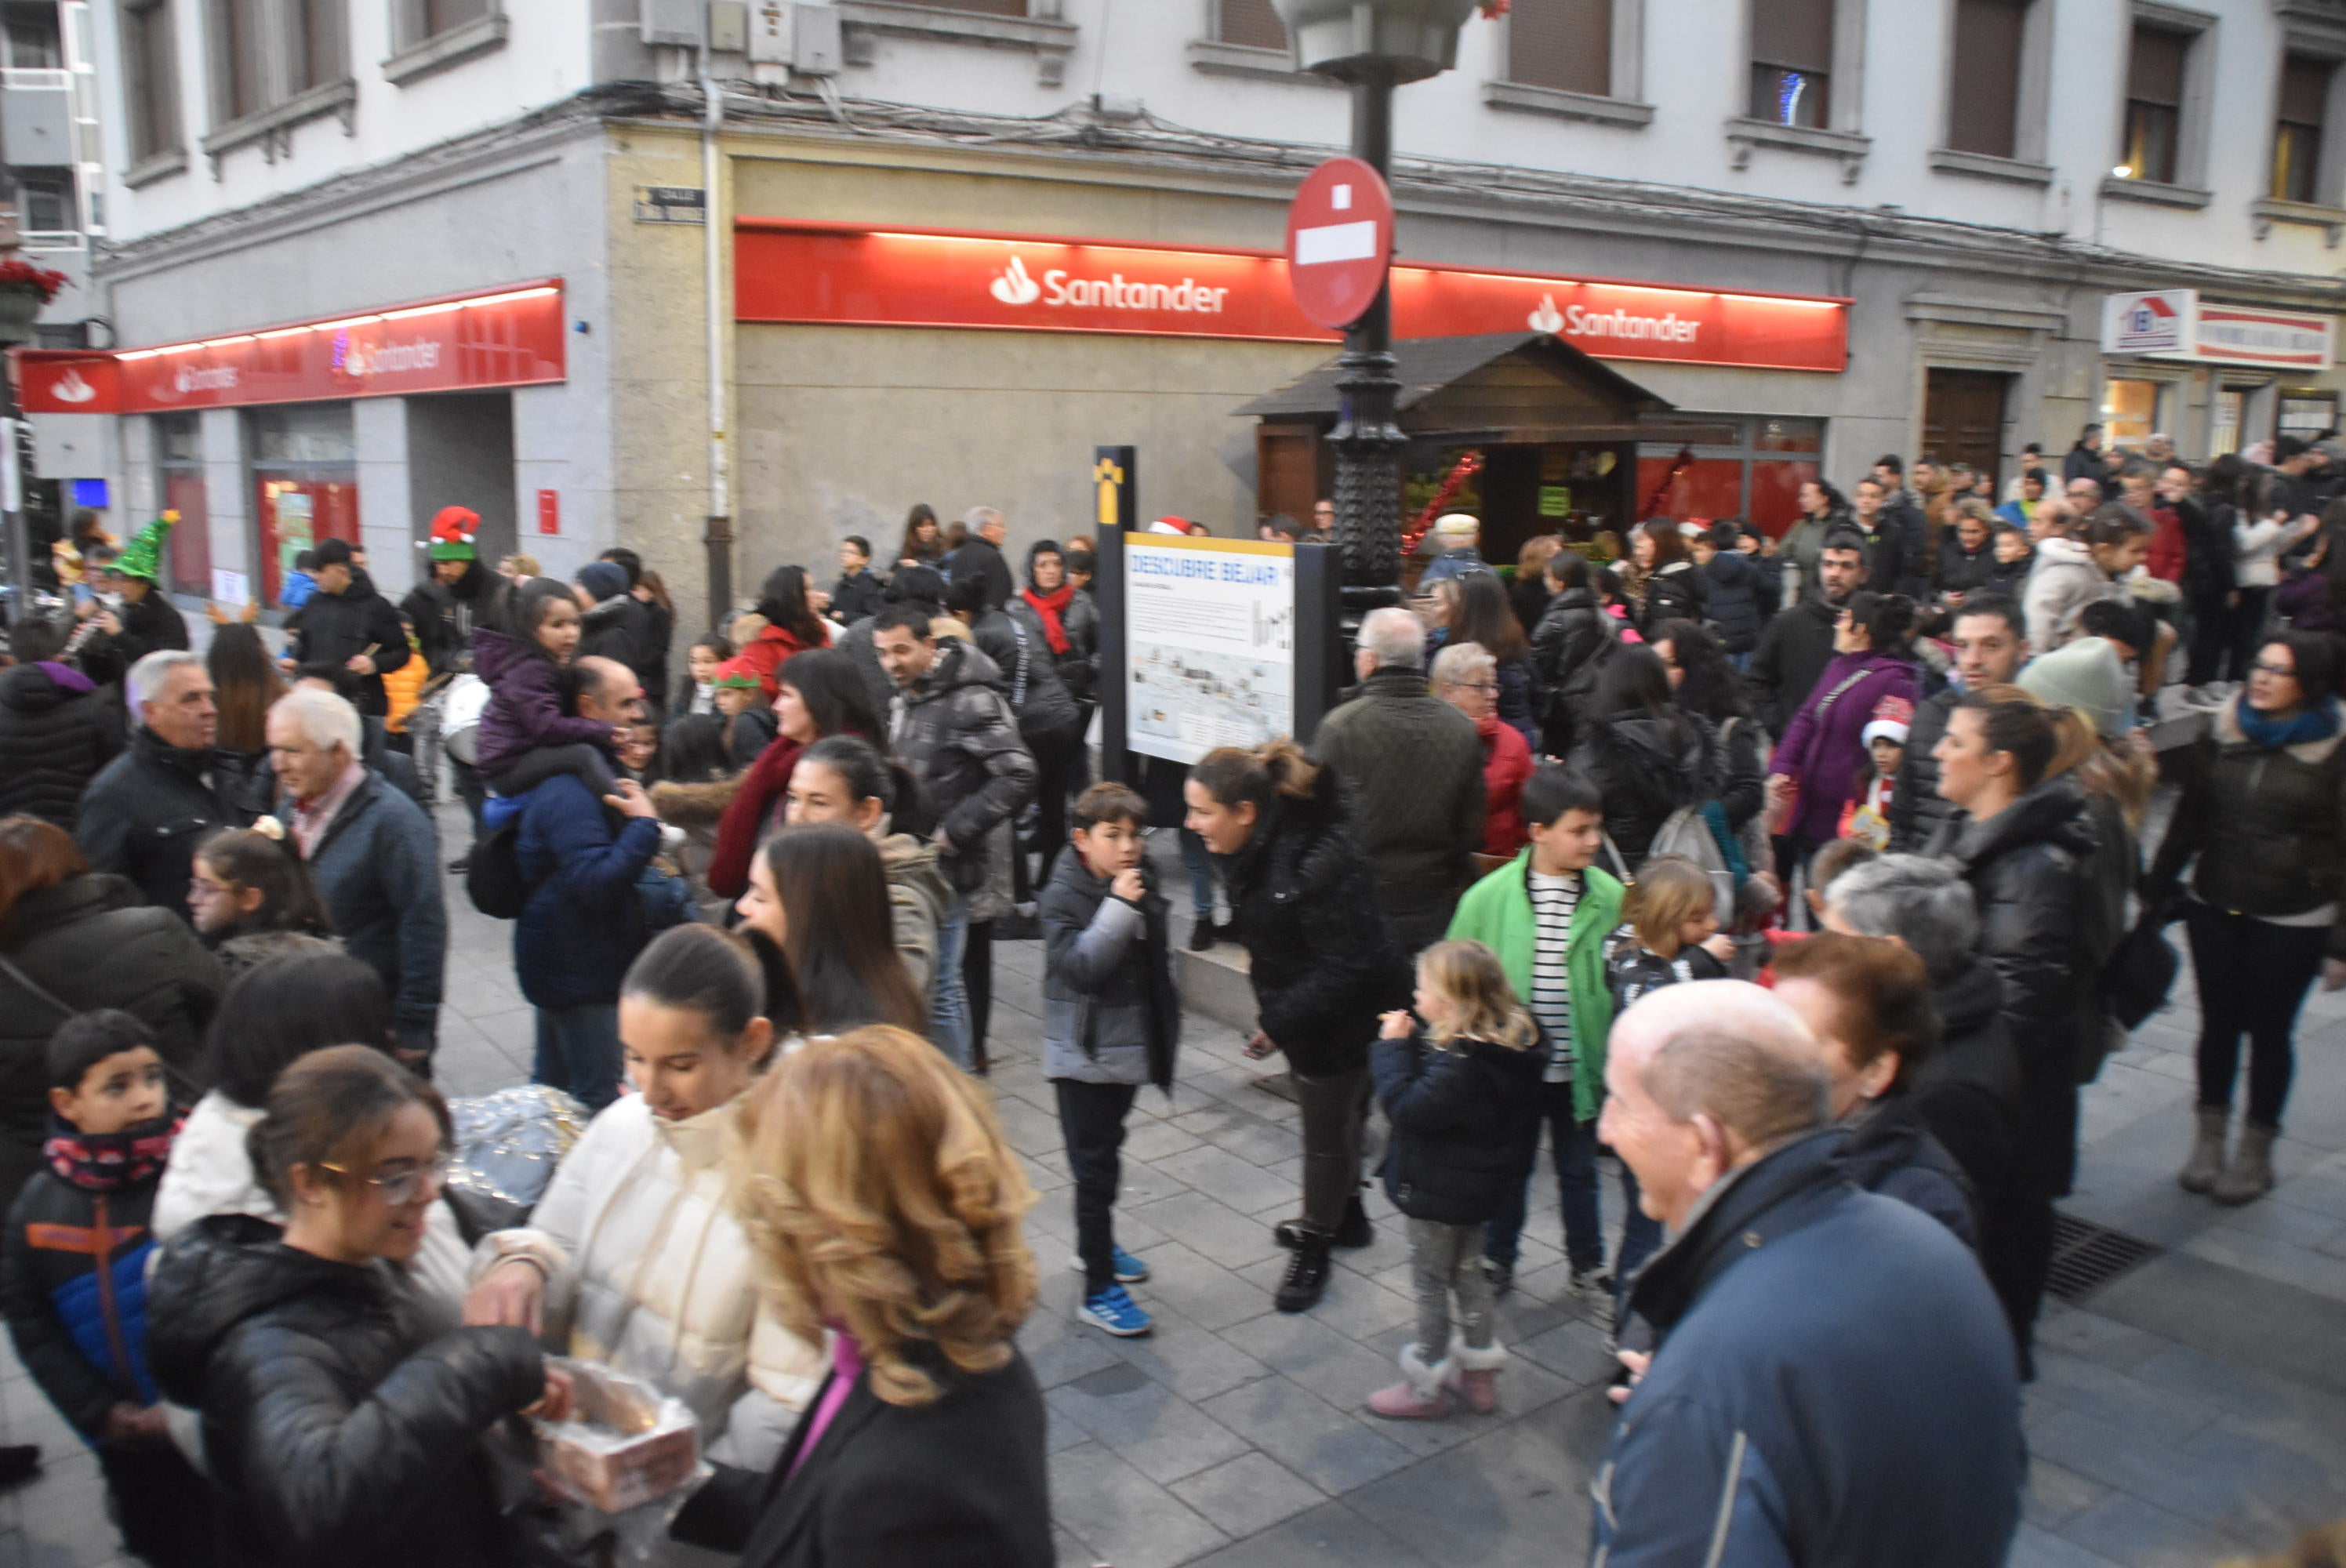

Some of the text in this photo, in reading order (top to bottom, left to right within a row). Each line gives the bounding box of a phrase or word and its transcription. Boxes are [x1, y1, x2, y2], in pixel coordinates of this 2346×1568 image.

[1044, 269, 1229, 313] Santander
[1566, 304, 1701, 343] Santander
[1131, 554, 1217, 581] DESCUBRE
